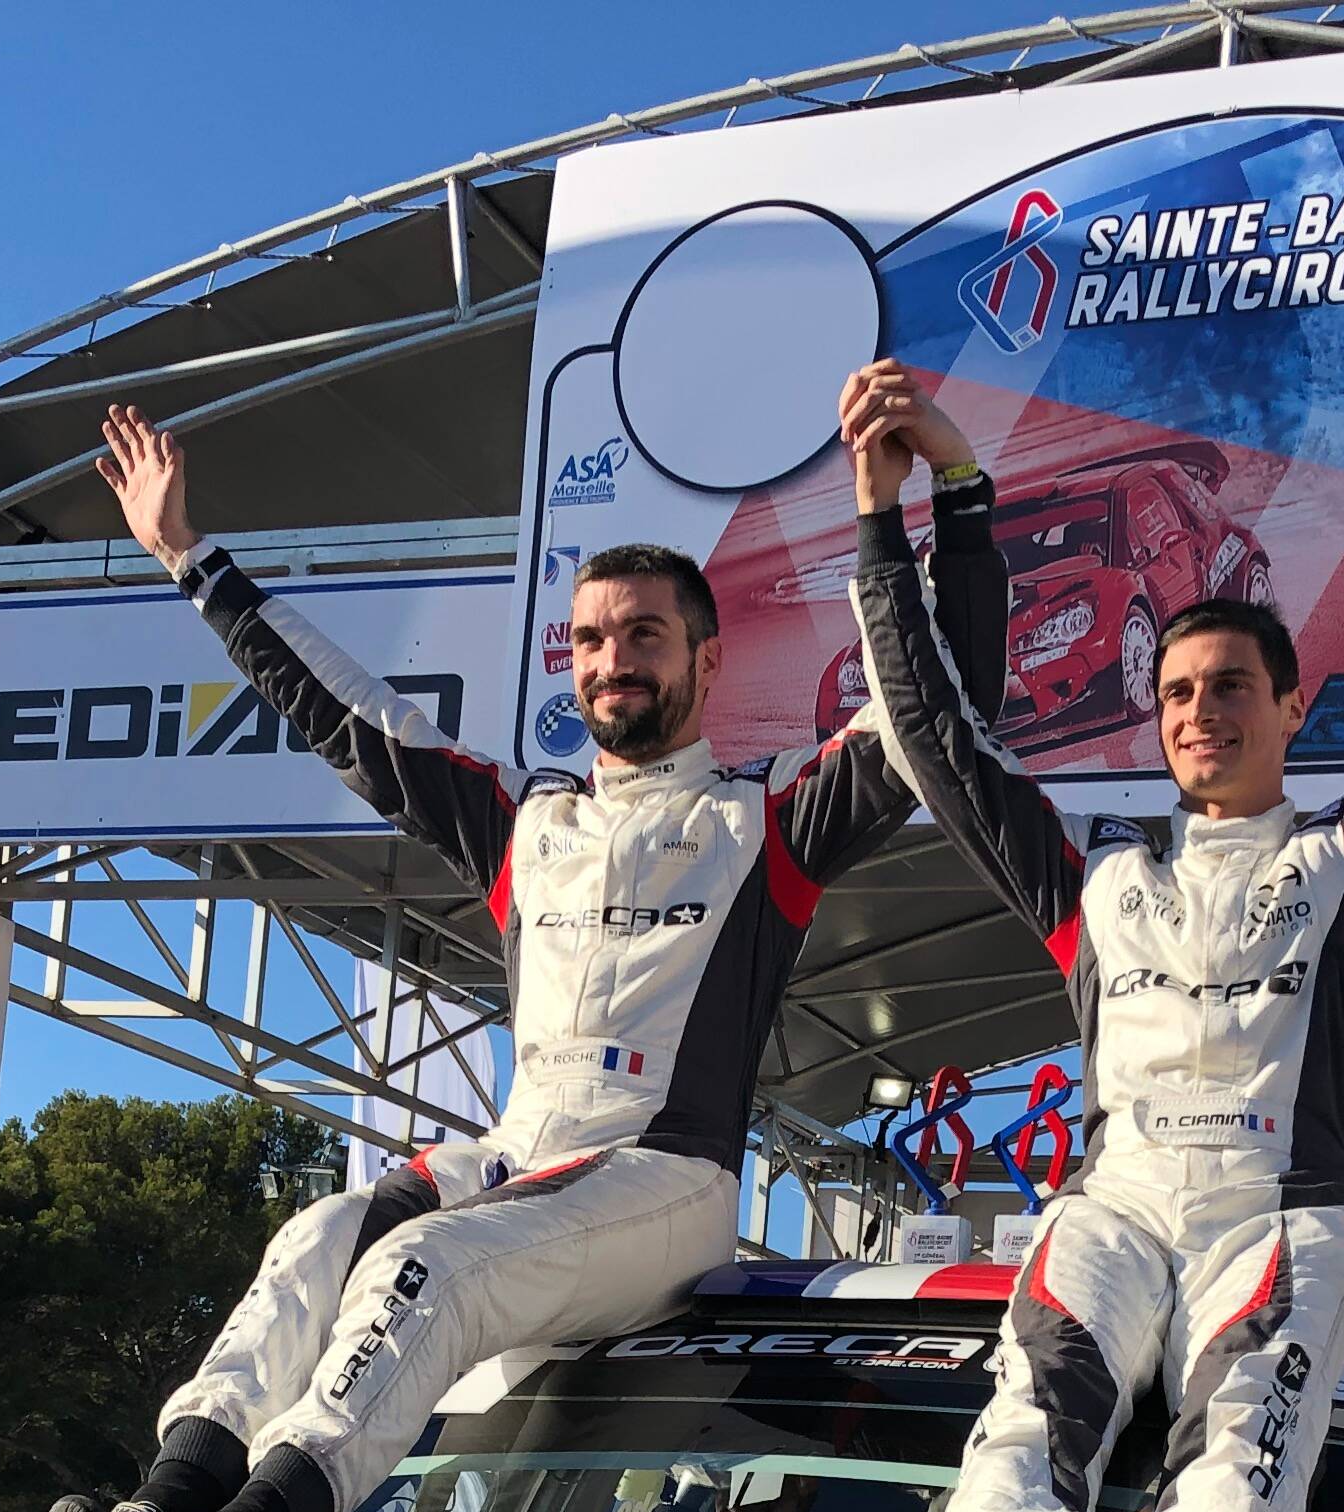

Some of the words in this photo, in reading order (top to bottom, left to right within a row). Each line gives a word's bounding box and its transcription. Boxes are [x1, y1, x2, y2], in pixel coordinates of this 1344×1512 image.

[557, 452, 613, 482] ASA
[551, 479, 615, 498] Marseille
[663, 841, 699, 853] AMATO
[553, 1051, 598, 1065] ROCHE
[1178, 1113, 1245, 1128] CIAMIN
[329, 1294, 405, 1400] ORECA
[605, 1333, 985, 1360] ORECA
[832, 1357, 960, 1371] STORE.COM
